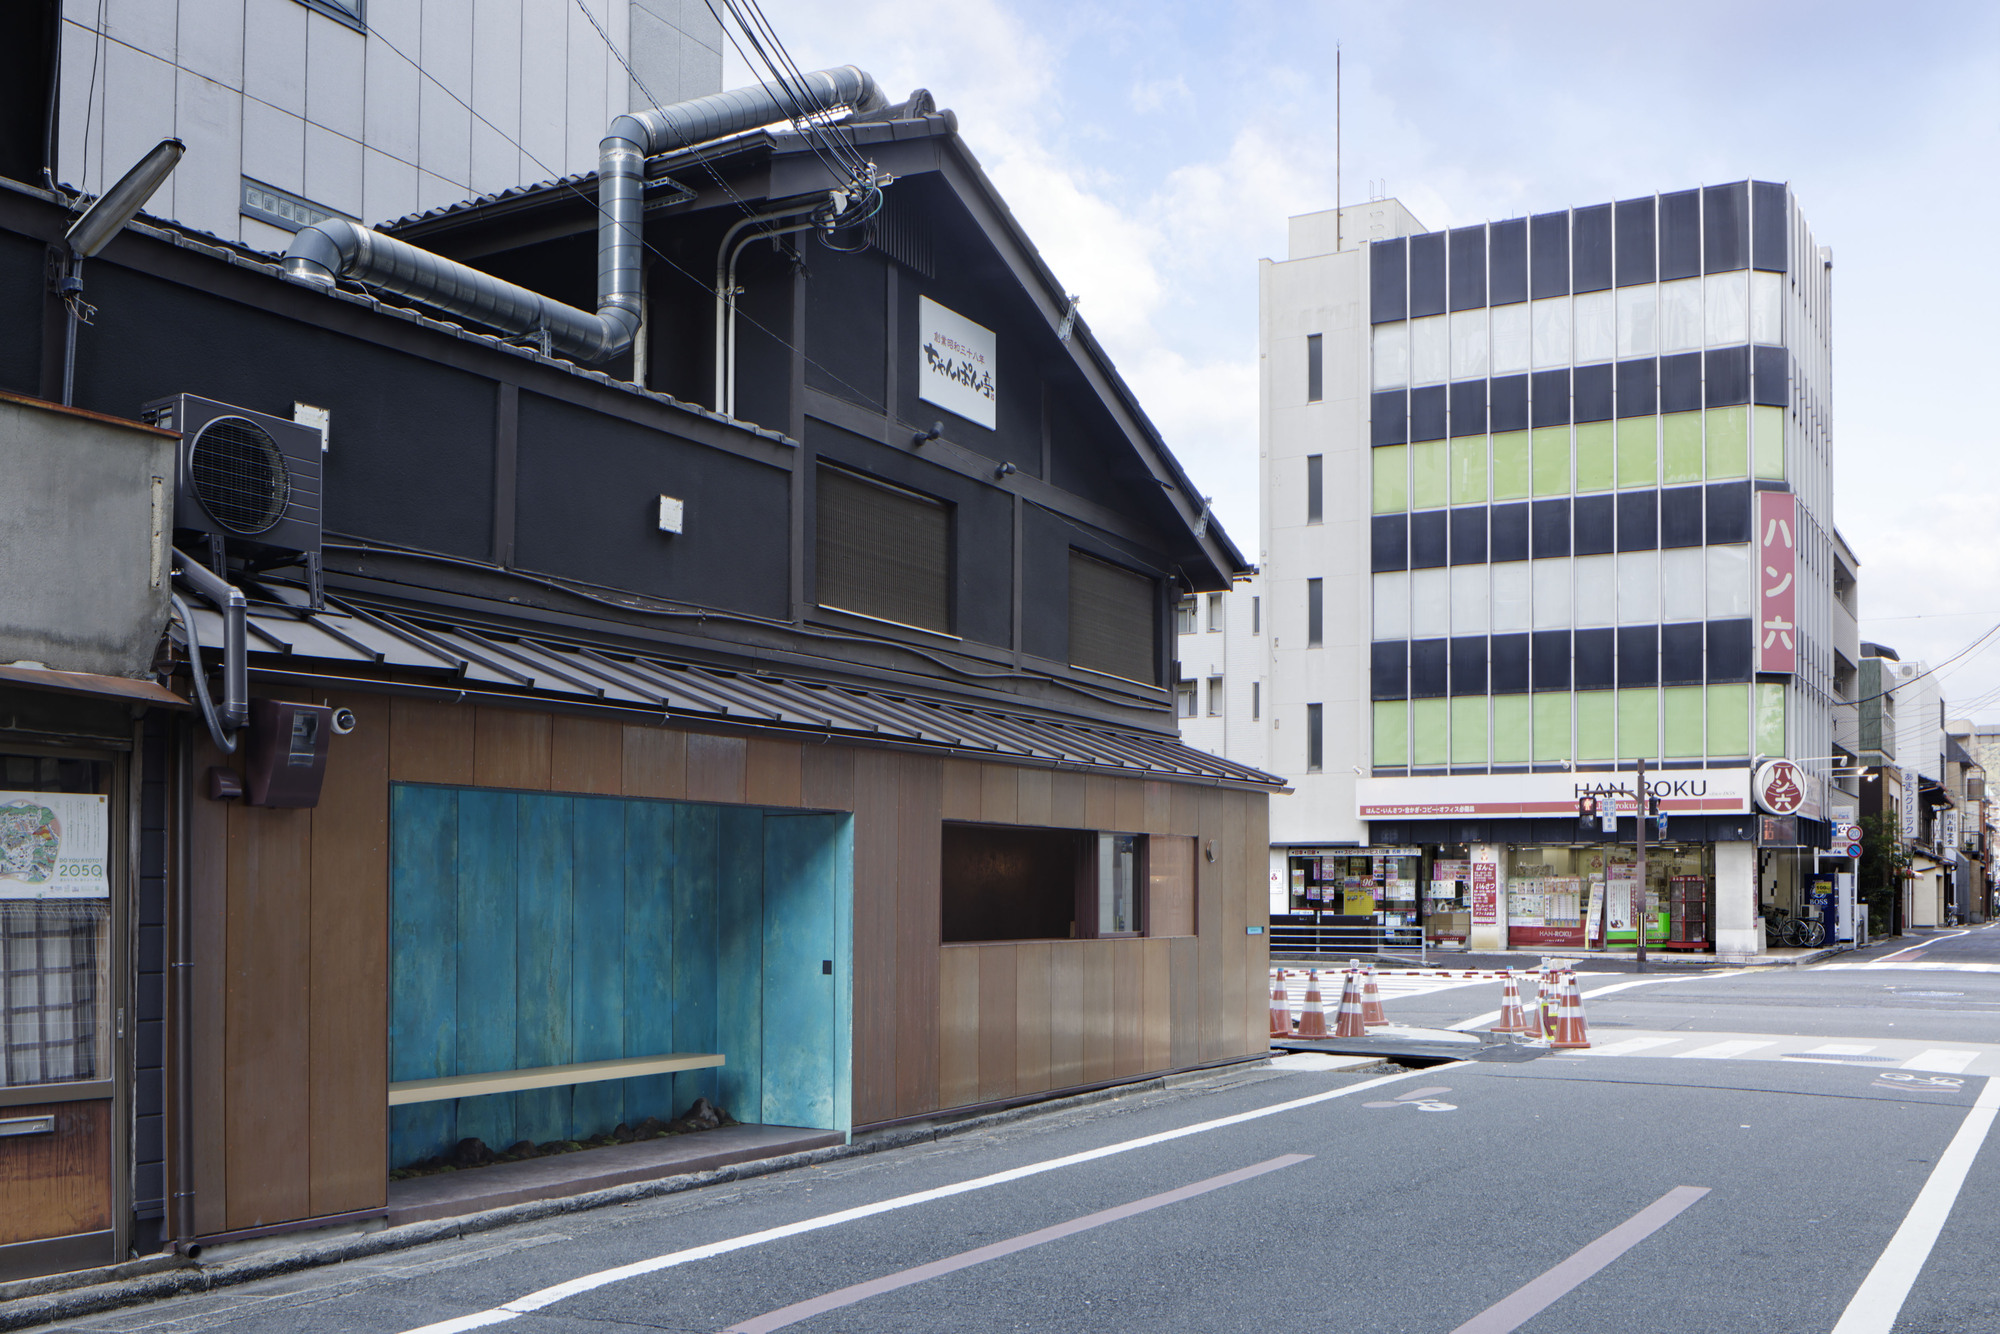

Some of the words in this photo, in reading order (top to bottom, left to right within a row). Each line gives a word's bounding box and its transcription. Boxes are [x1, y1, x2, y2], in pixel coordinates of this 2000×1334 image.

[923, 342, 994, 399] ちゃんぽん亭
[933, 331, 985, 365] 創業昭和三十八年
[1763, 518, 1793, 650] ハン六
[1775, 768, 1792, 810] ハン六
